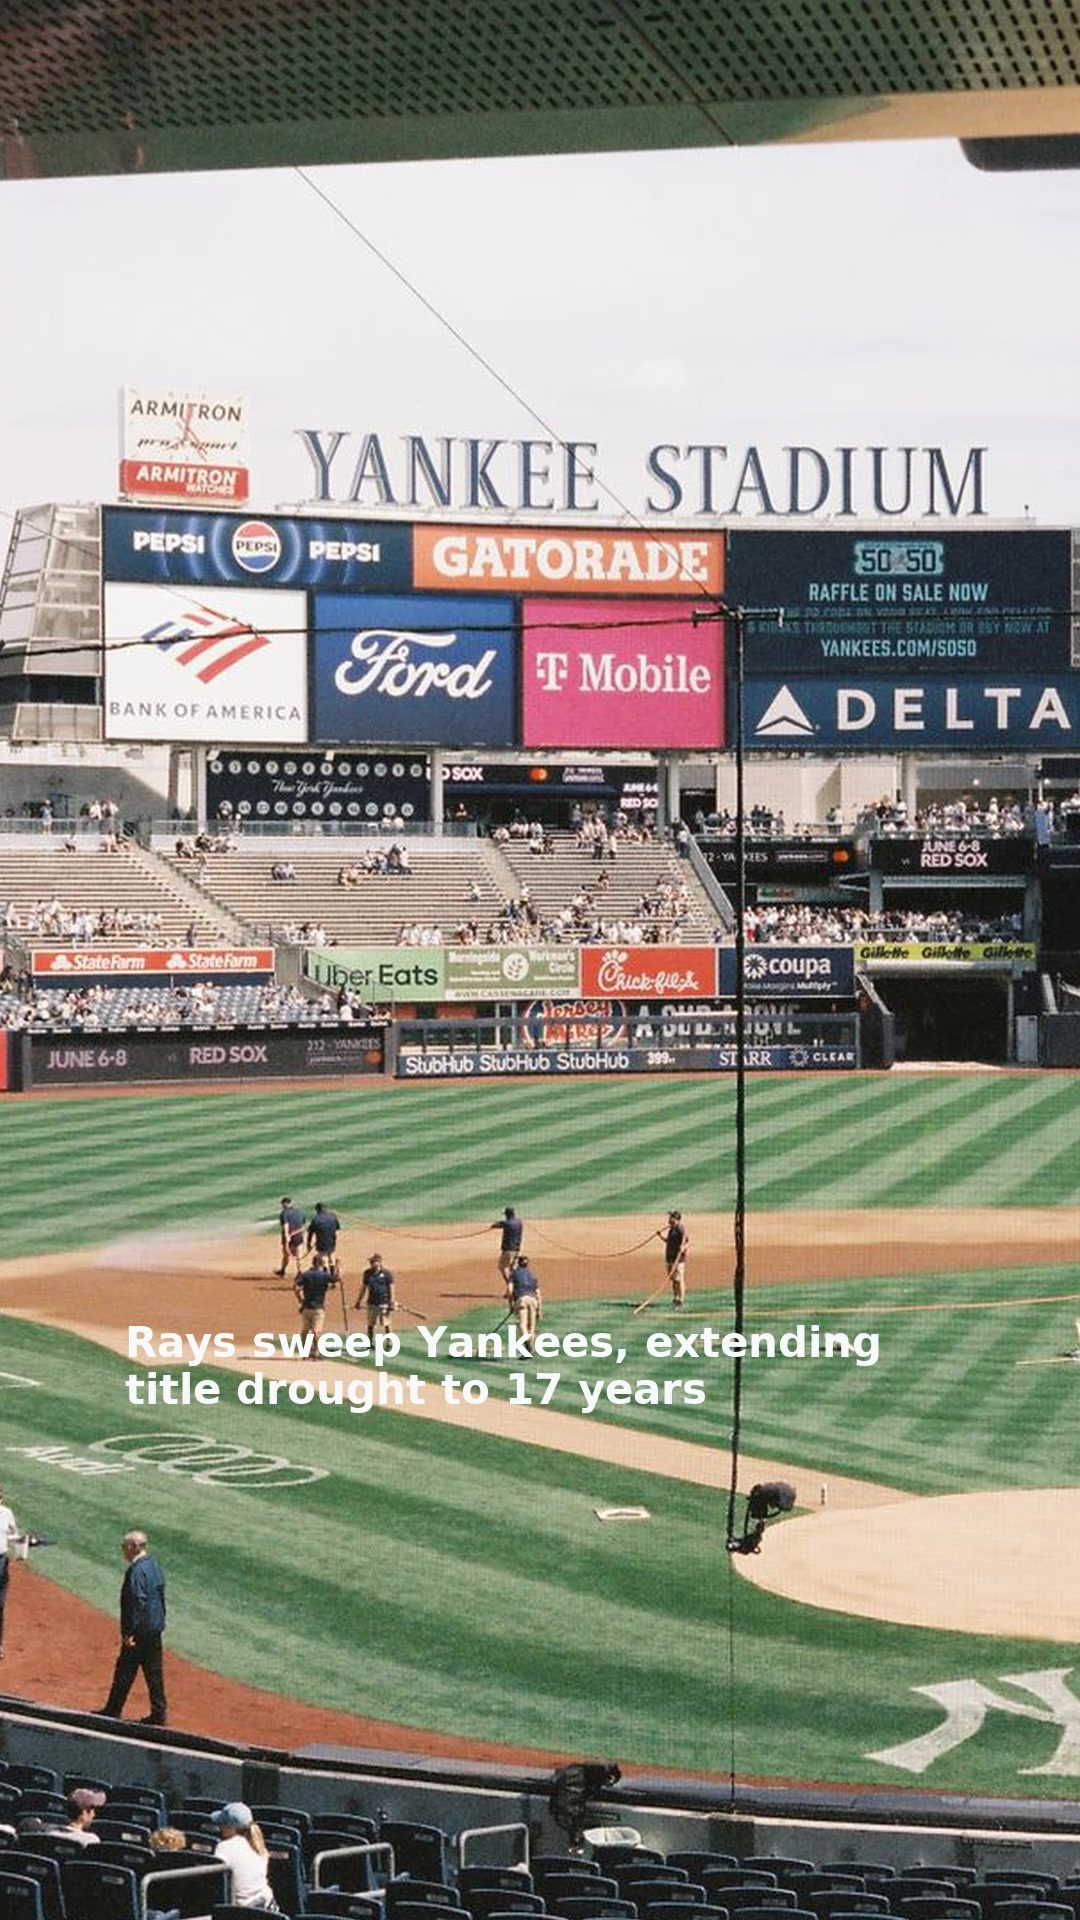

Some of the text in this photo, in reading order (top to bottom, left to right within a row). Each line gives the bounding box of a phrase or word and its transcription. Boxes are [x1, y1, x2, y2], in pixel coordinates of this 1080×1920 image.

[131, 399, 241, 421] ARMITRON
[136, 465, 237, 487] ARMITRON
[293, 429, 989, 517] YANKEE STADIUM
[133, 531, 205, 555] PEPSI
[235, 540, 279, 554] PEPSI
[309, 541, 381, 563] PEPSI
[432, 535, 709, 582] GATORADE
[861, 549, 937, 573] 50 50
[809, 583, 988, 602] RAFFLE ON SALE NOW
[334, 630, 497, 699] Ford
[536, 652, 711, 693] T Mobile
[110, 701, 302, 722] BANK OF AMERICA
[836, 687, 1072, 730] DELTA
[452, 766, 484, 781] SOX
[272, 779, 364, 799] New York Yankees
[922, 841, 981, 853] JUNE 6-8
[920, 853, 952, 867] RED
[954, 853, 989, 868] SOX
[860, 946, 1033, 960] Gillette Gillette Gillette
[315, 964, 438, 988] Uber Eats
[598, 951, 699, 994] Chick-fil-A
[769, 957, 832, 979] coupa
[47, 1050, 95, 1069] JUNE
[97, 1049, 128, 1068] 6-8
[189, 1046, 230, 1065] RED
[233, 1045, 268, 1064] SOX
[406, 1052, 629, 1074] StubHub StubHub StubHub
[812, 1052, 855, 1062] CLEAR
